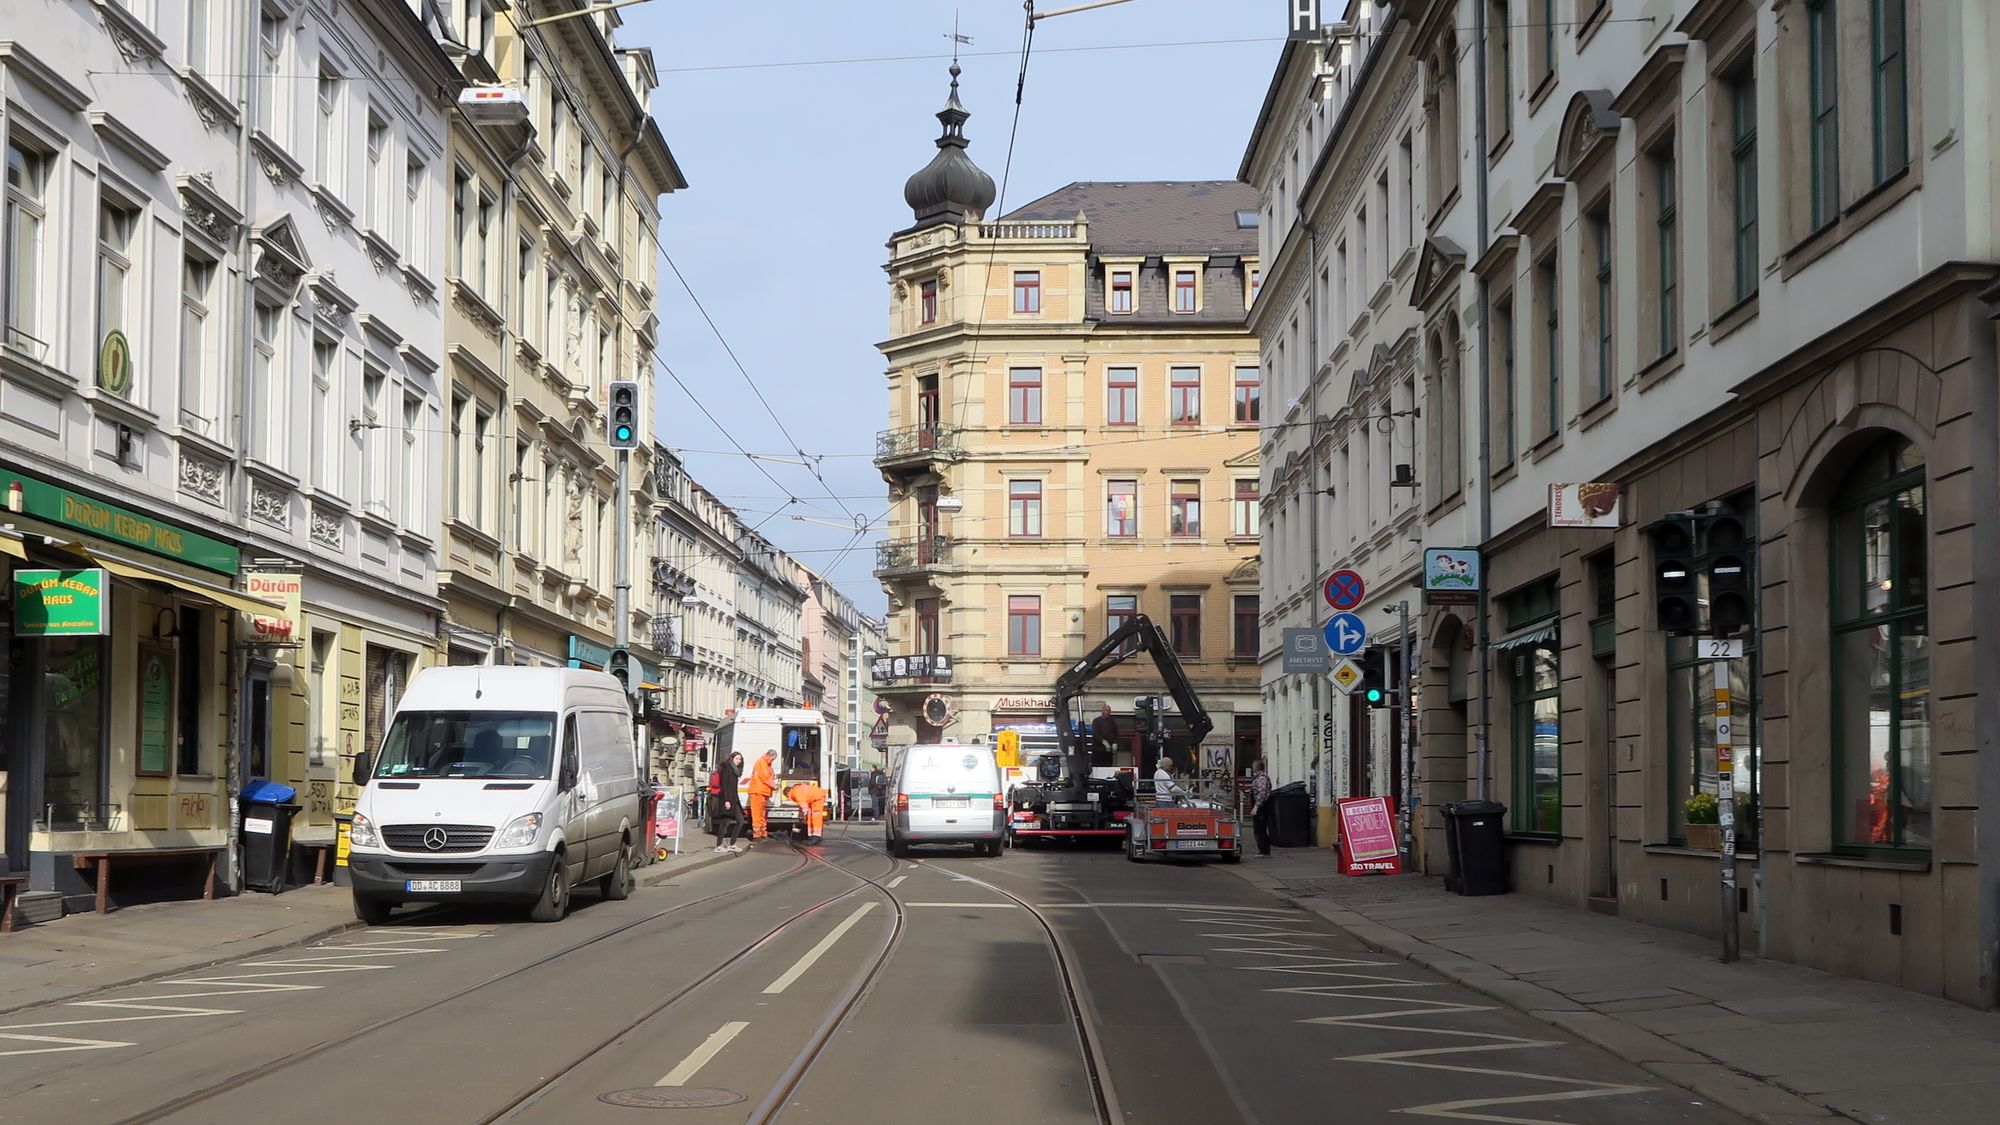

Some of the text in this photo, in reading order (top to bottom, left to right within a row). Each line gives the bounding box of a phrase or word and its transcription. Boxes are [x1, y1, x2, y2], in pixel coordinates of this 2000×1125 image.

[1293, 0, 1316, 31] H
[114, 512, 152, 543] KEBAP
[155, 526, 184, 553] HAUS
[62, 579, 98, 596] KEBAP
[250, 578, 300, 593] Dürüm
[43, 594, 74, 605] HAUS
[1710, 641, 1730, 657] 22
[994, 697, 1057, 709] Musikhaus
[1364, 862, 1395, 871] TRAVEL
[413, 881, 423, 891] DD
[429, 881, 439, 891] AC
